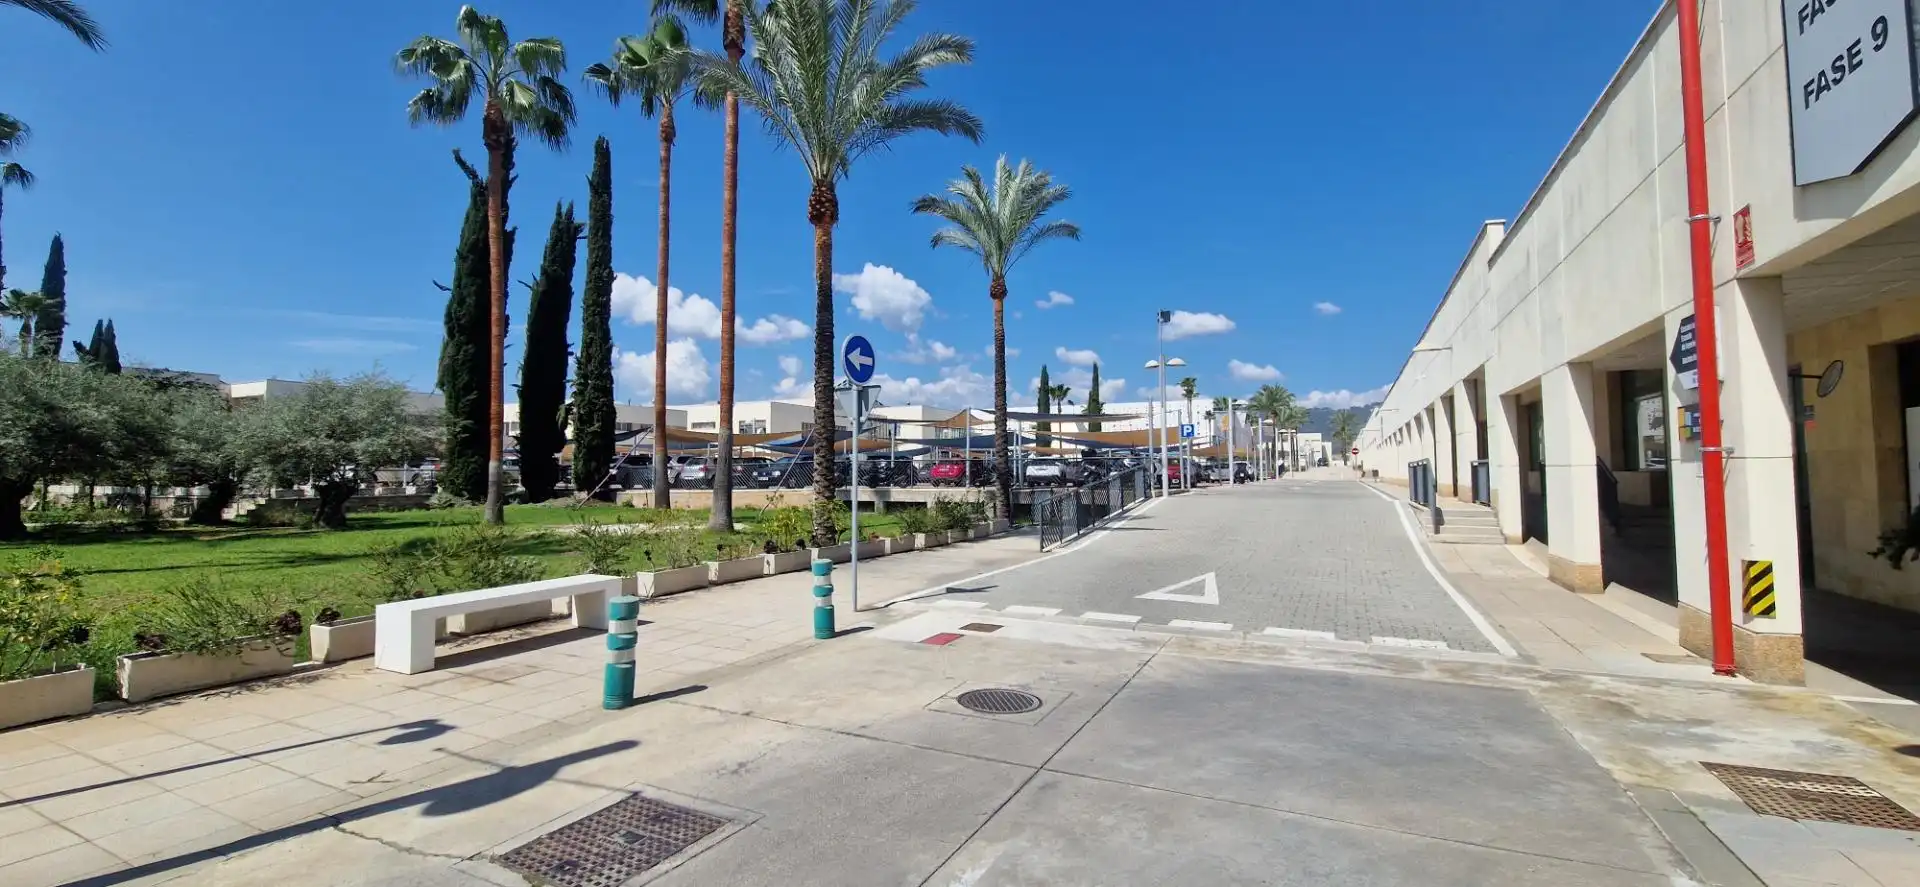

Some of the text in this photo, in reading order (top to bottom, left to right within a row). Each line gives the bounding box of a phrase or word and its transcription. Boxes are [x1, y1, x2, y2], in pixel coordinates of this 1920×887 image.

[1803, 15, 1889, 110] FASE 9
[1183, 425, 1193, 437] P
